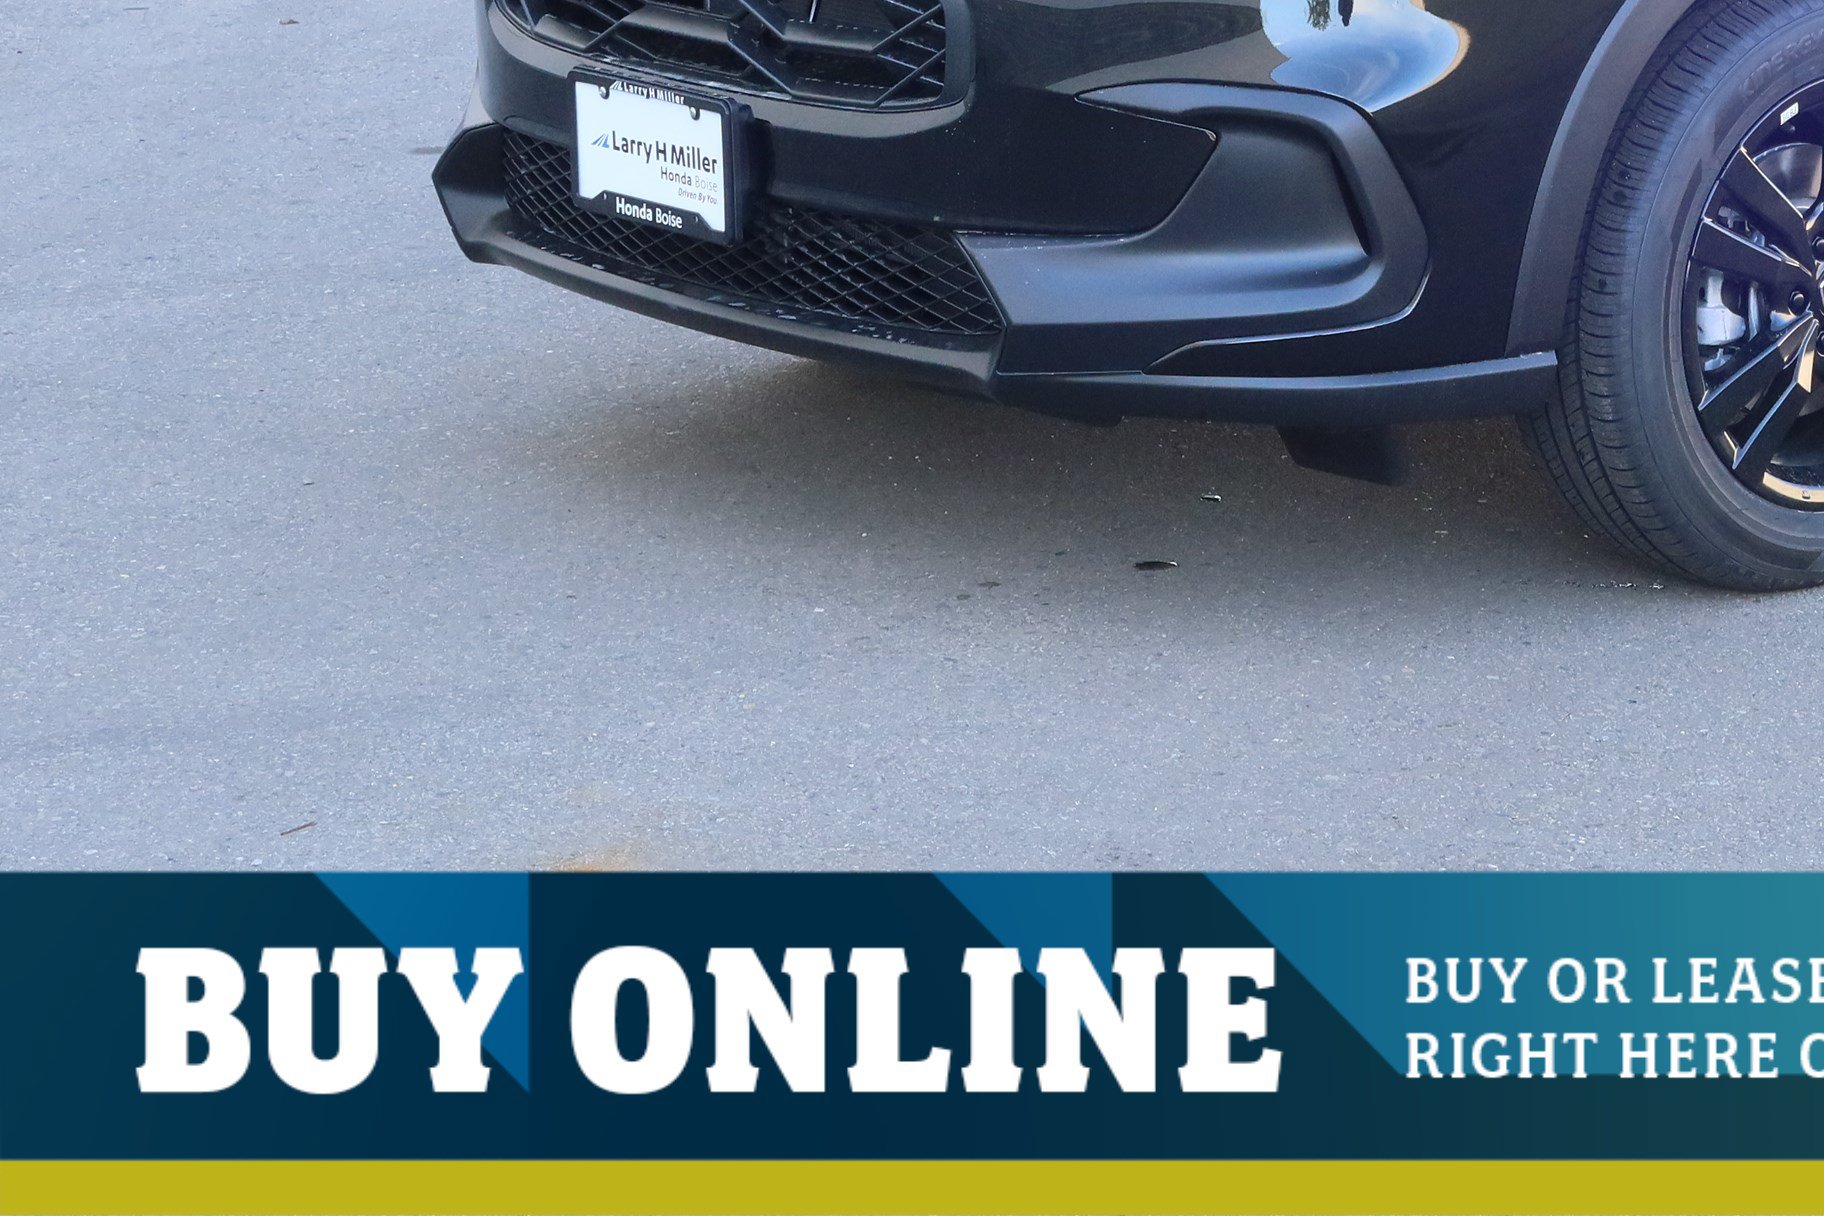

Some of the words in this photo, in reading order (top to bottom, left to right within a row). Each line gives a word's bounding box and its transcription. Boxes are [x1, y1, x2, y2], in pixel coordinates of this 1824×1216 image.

[623, 82, 648, 98] Larry
[648, 87, 656, 99] H
[656, 89, 685, 105] Miller
[612, 130, 652, 164] Larry
[655, 140, 667, 162] H
[670, 144, 718, 174] Miller
[660, 166, 692, 186] Honda
[694, 175, 718, 193] Boise
[678, 188, 697, 200] Driven
[698, 192, 706, 203] By
[707, 195, 718, 205] You
[615, 196, 653, 222] Honda
[655, 207, 683, 229] Boise
